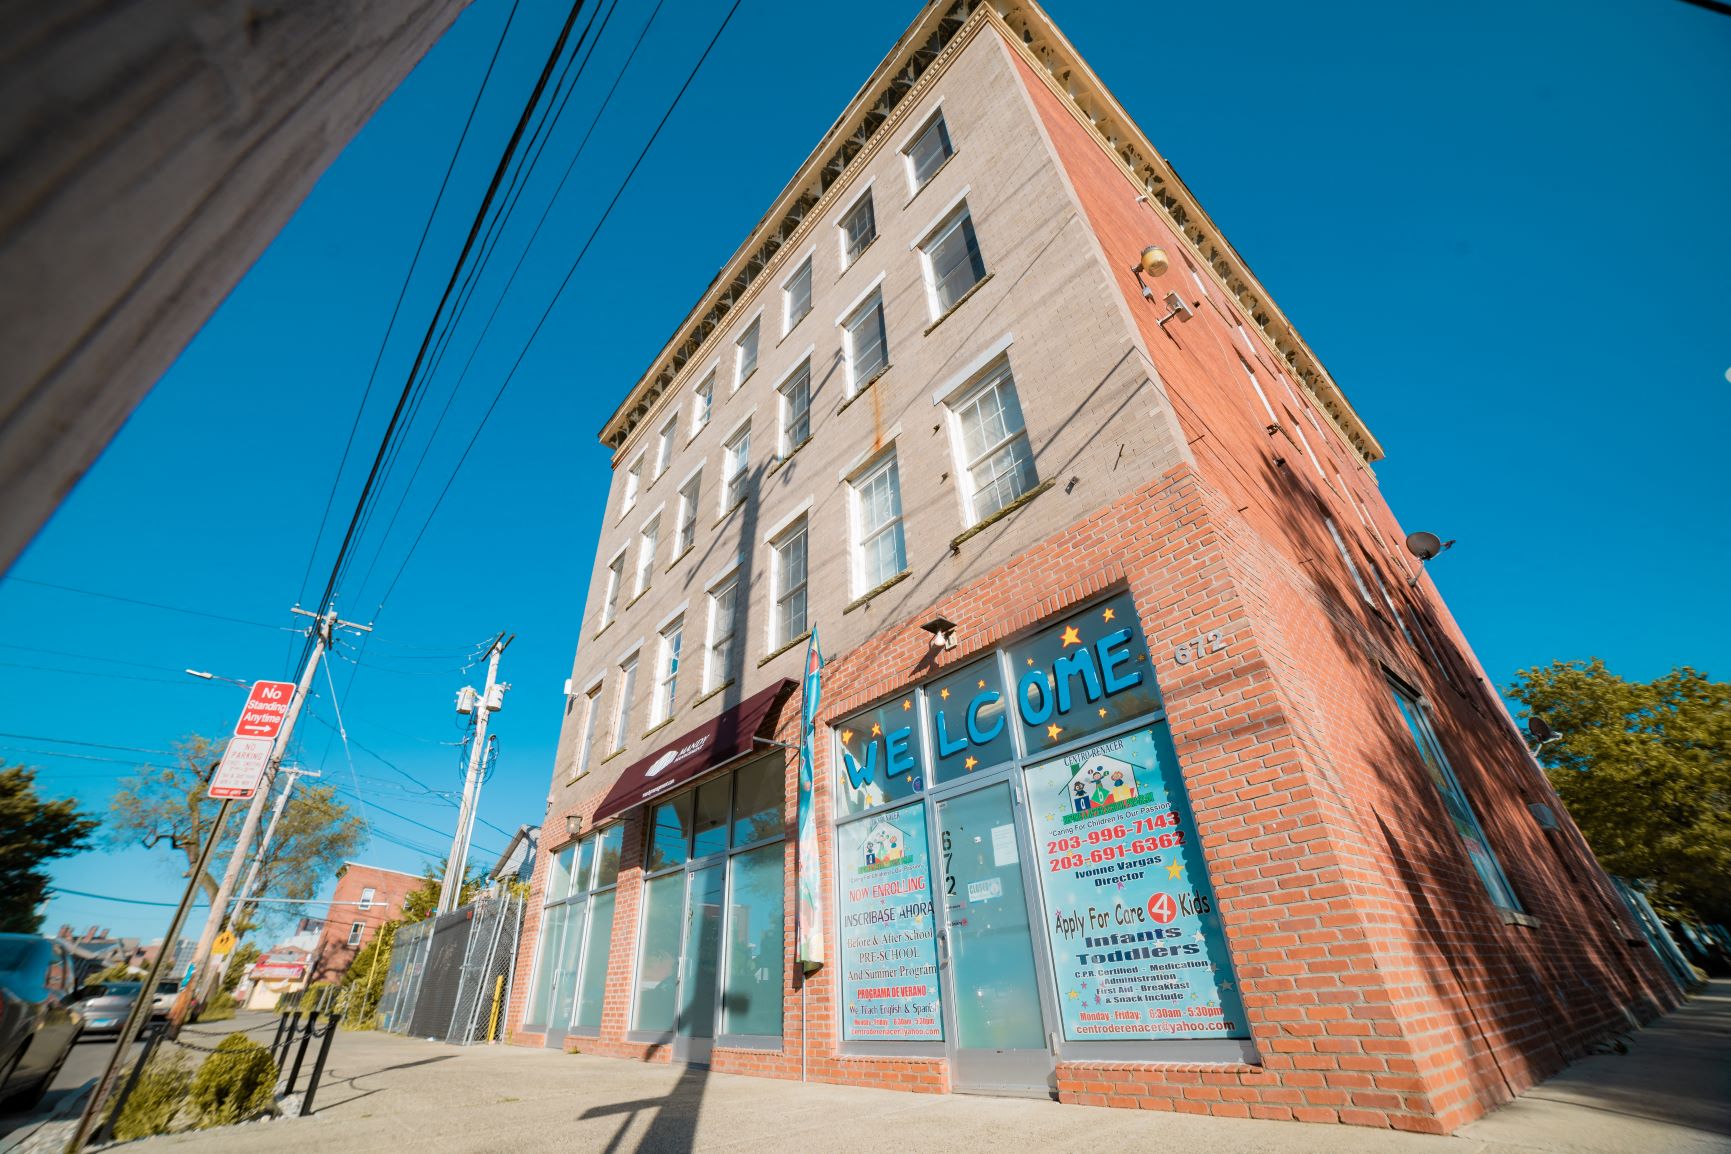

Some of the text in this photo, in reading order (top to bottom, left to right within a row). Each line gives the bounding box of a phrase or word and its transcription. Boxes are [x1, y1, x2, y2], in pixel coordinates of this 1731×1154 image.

[1175, 629, 1227, 665] 672
[261, 687, 282, 699] No
[248, 699, 288, 713] Standing
[844, 626, 1142, 789] WELCOME
[678, 734, 710, 757] MANDY
[1091, 739, 1124, 758] RENACER
[231, 752, 263, 760] PARKING
[1074, 823, 1085, 831] For
[1087, 815, 1116, 828] Children
[1125, 810, 1139, 818] Our
[1047, 811, 1180, 854] 203-996-7143
[1050, 830, 1186, 872] 203-691-6362
[1075, 855, 1162, 879] Ivonne Vargas
[1094, 871, 1145, 887] Director
[849, 876, 925, 902] NOW ENROLLING
[845, 901, 934, 927] INSCRIBASE AHORA
[1055, 890, 1211, 940] Apply For Care 4 Kids
[847, 928, 933, 948] Before & After School
[1084, 927, 1182, 948] Infants
[859, 946, 920, 963] PRE-SCHOOL
[1076, 943, 1201, 965] Toddlers
[848, 964, 937, 980] And Summer Program
[1074, 970, 1097, 979] C.P.R.
[1097, 966, 1139, 977] Certified
[1150, 960, 1209, 972] Medication
[1104, 973, 1177, 985] Administration
[857, 985, 927, 1000] PROGRAMA DE VERANO
[1096, 985, 1116, 995] First
[1118, 984, 1134, 993] Aid
[1140, 981, 1190, 992] Breakfast
[1114, 995, 1144, 1004] Snack
[1145, 993, 1184, 1002] Include
[849, 1006, 858, 1014] We
[861, 1005, 878, 1014] Teach
[880, 1004, 901, 1016] English
[904, 1004, 910, 1013] &
[1080, 1011, 1110, 1021] Monday
[1114, 1010, 1142, 1020] Friday:
[1149, 1008, 1182, 1019] 6:30am
[1187, 1007, 1224, 1018] 5:30pm
[1076, 1020, 1236, 1035] centroderenacer@yahoo.com
